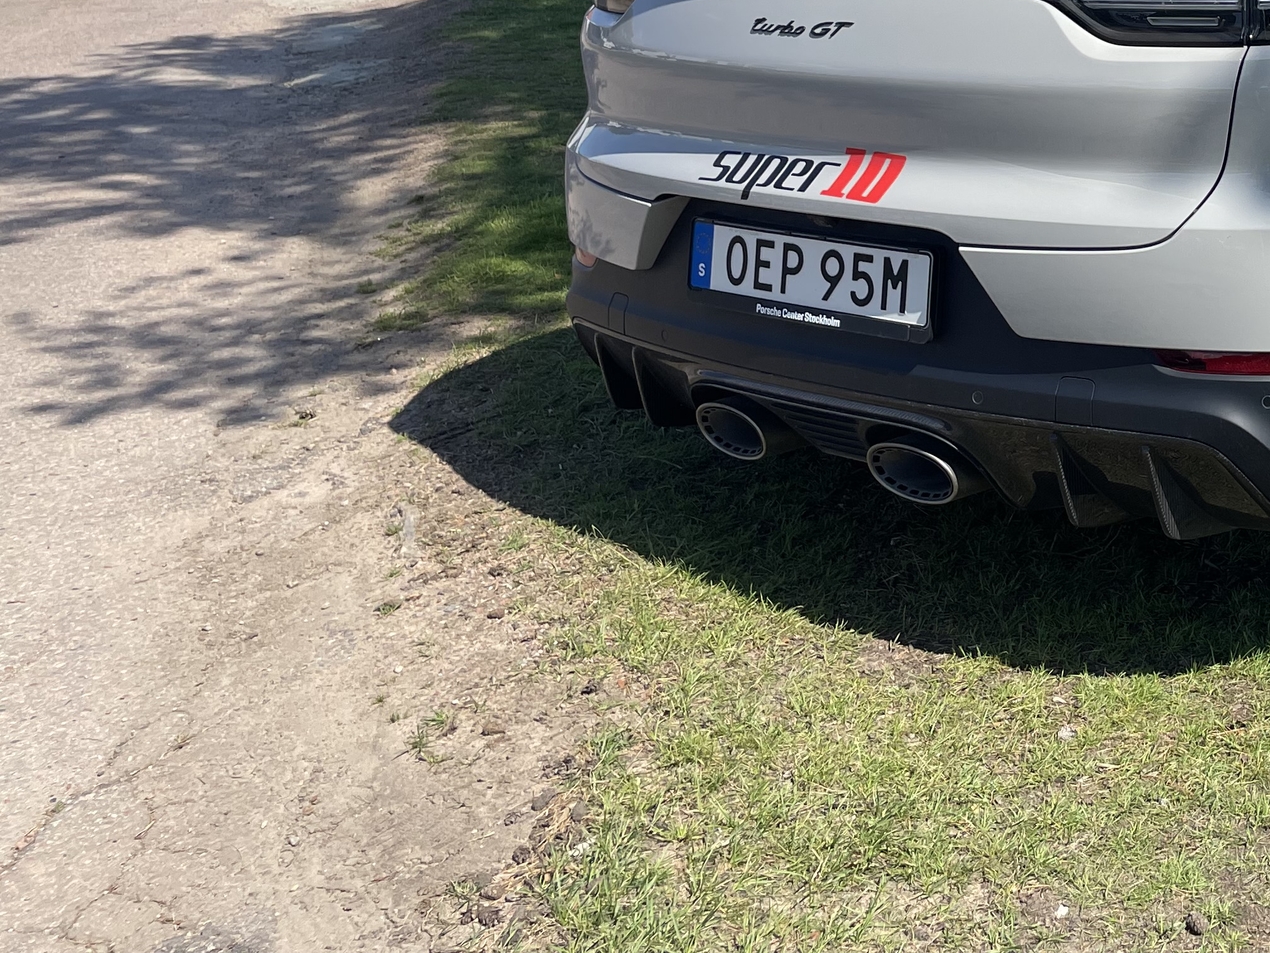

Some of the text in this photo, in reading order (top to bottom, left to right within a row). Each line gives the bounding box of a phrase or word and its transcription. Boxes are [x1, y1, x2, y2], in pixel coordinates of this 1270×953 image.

[750, 17, 854, 39] turbo GT
[698, 263, 706, 276] S
[726, 235, 909, 314] OEP 95M
[756, 303, 841, 328] Porsche Center Stockholm
